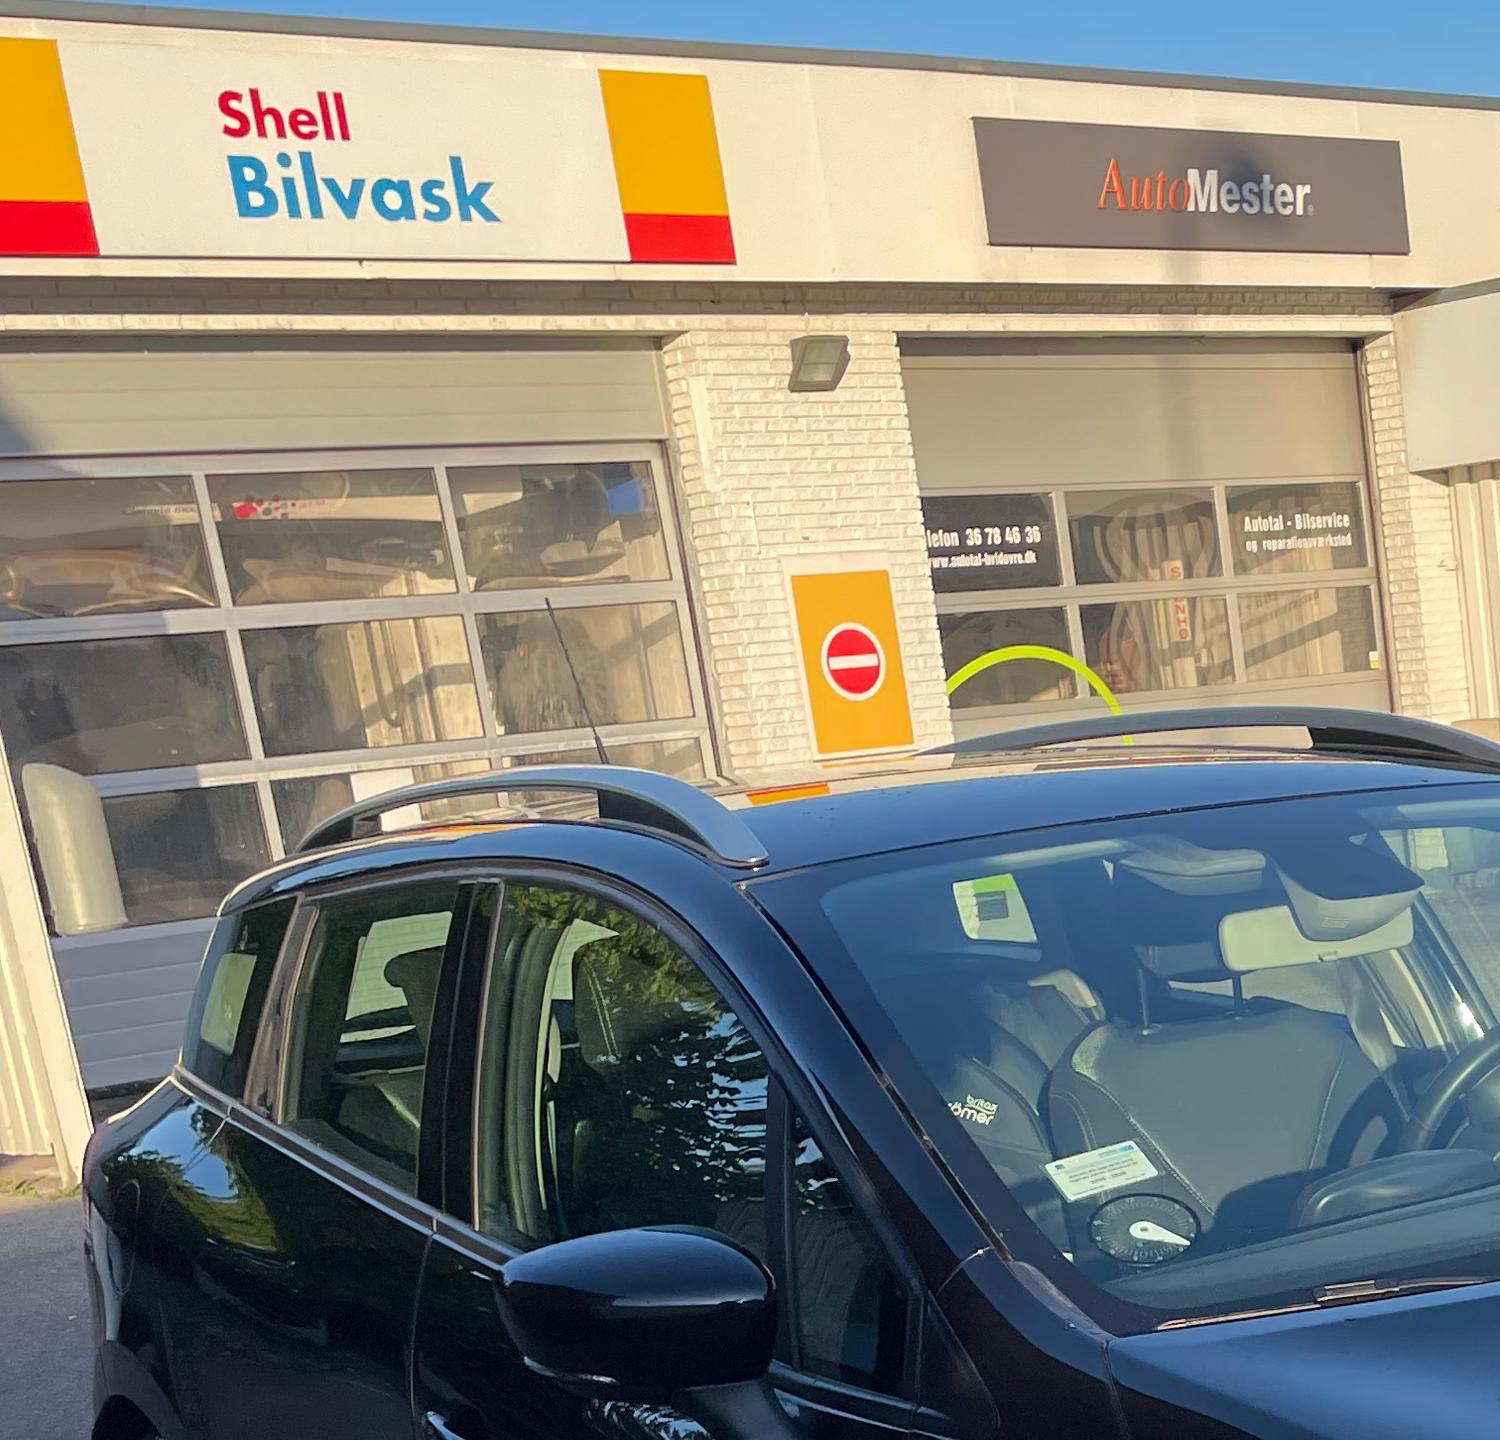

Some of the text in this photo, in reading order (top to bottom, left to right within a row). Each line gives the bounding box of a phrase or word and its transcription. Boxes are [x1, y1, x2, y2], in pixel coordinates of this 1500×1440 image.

[218, 88, 351, 141] Shell
[227, 152, 502, 223] Bilvask
[1098, 158, 1312, 216] AutoMester
[927, 525, 1041, 548] lefon 36 78 46 36
[1244, 514, 1284, 532] Autotal
[1295, 512, 1350, 530] Bilservice
[1245, 540, 1258, 553] og
